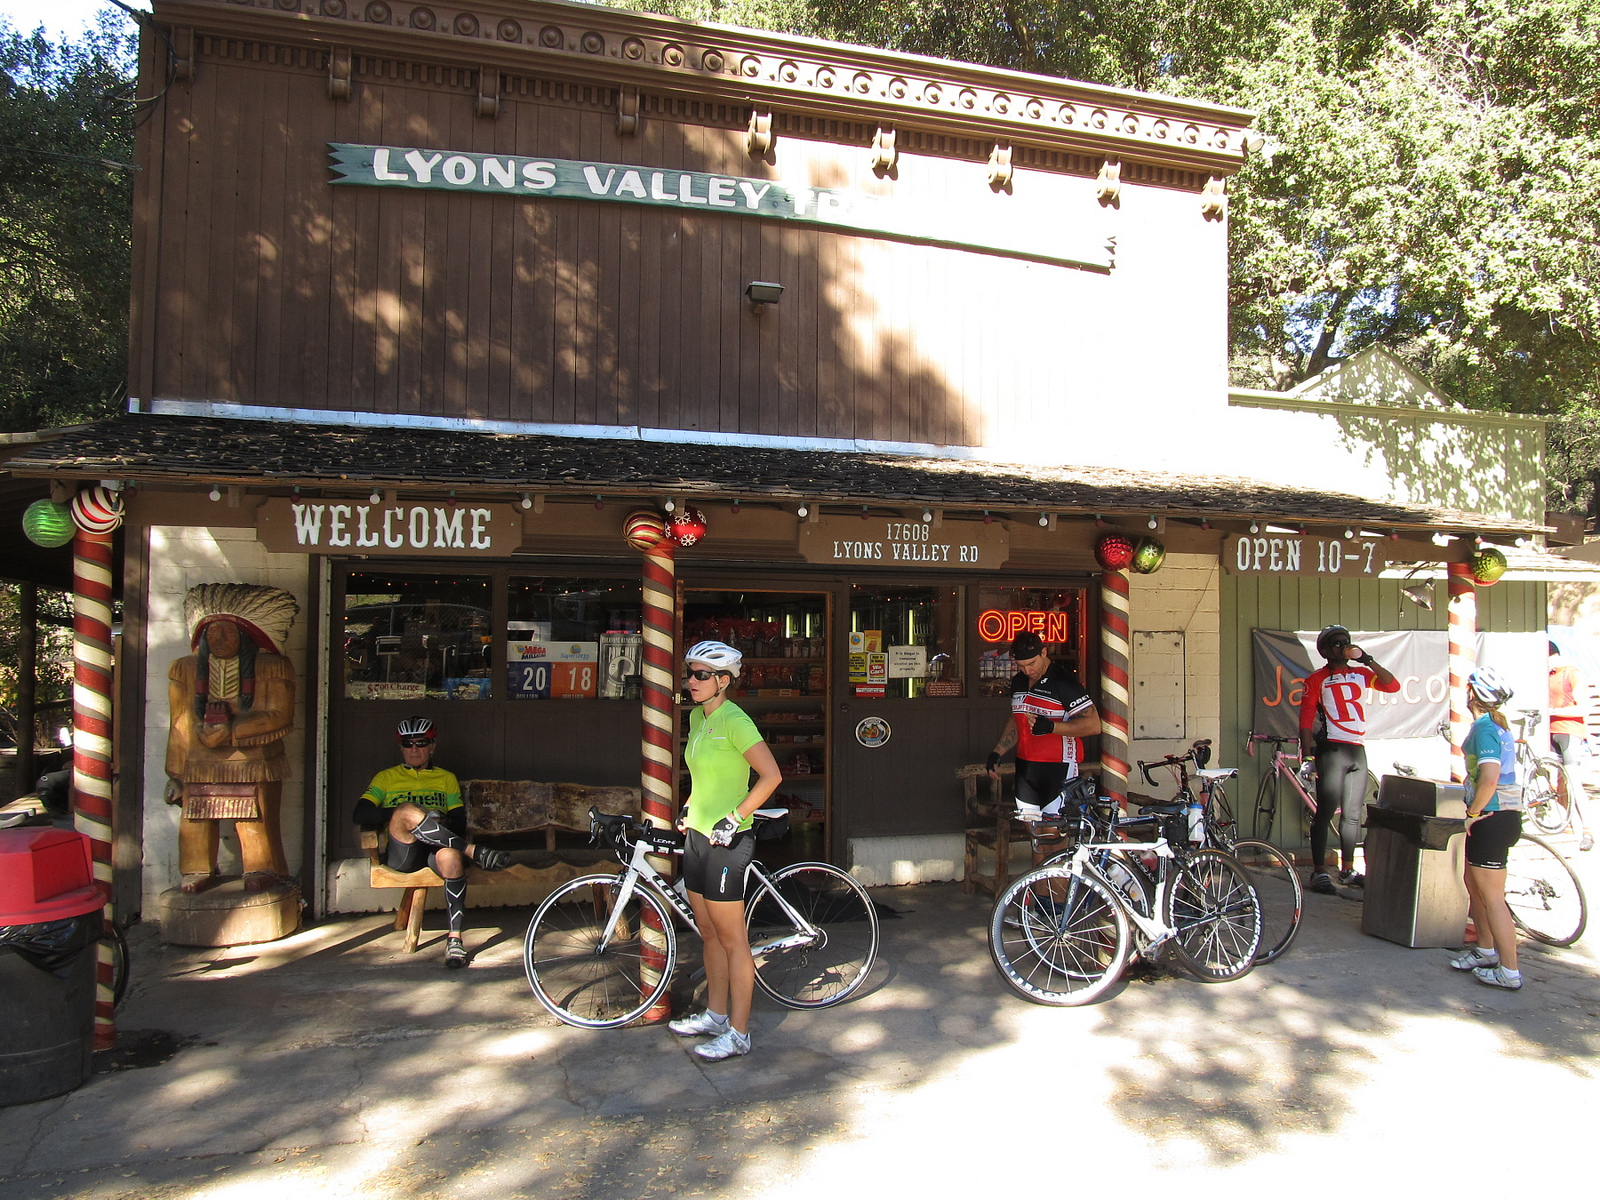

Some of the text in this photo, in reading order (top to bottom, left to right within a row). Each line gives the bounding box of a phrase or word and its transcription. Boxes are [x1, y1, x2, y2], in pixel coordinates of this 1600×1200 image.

[373, 147, 557, 190] LYONS
[583, 165, 771, 211] VALLEY
[292, 503, 492, 549] WELCOME
[886, 522, 930, 541] 17608
[833, 541, 979, 563] LYONS VALLEY RD
[1236, 536, 1377, 574] OPEN 10-7
[979, 609, 1068, 642] OPEN
[523, 645, 546, 655] MEGA
[523, 667, 547, 691] 20
[569, 667, 592, 691] 18
[1325, 682, 1366, 722] R
